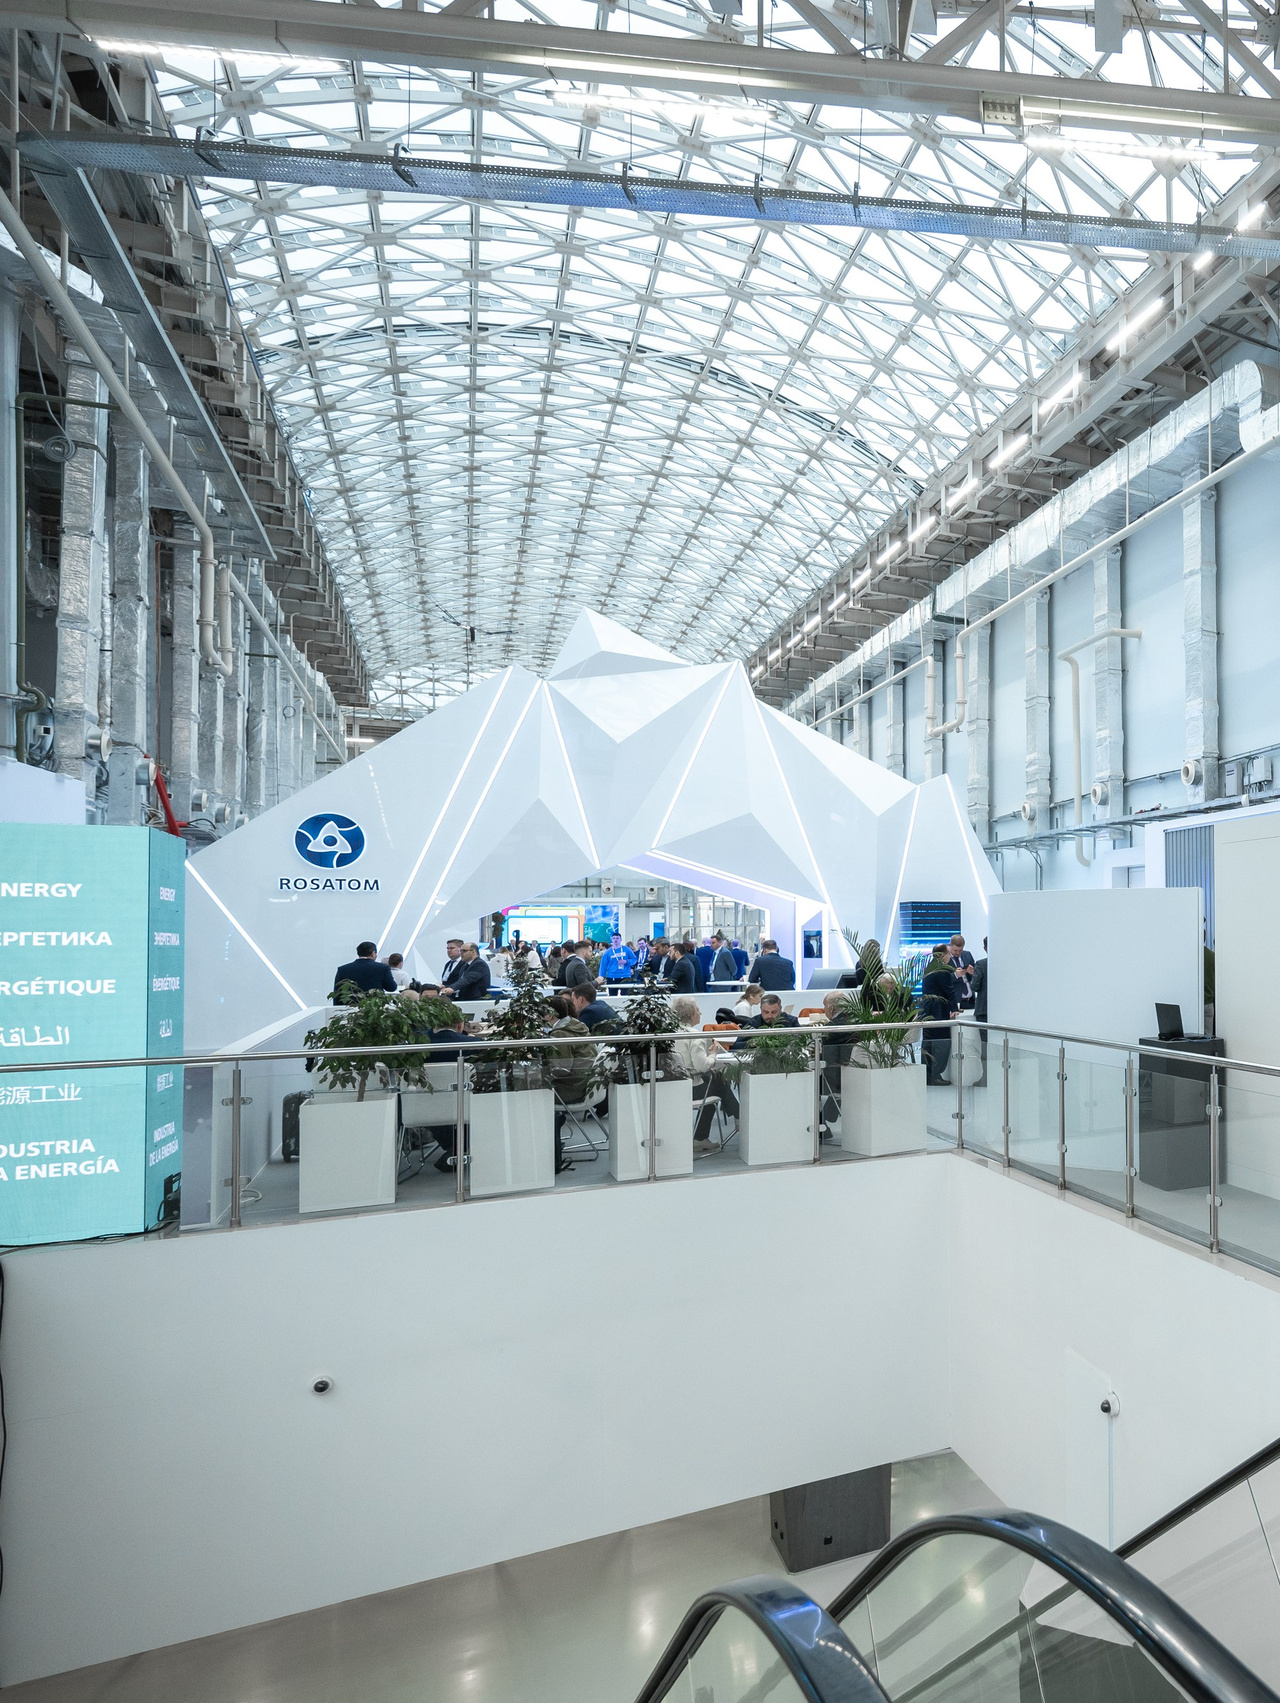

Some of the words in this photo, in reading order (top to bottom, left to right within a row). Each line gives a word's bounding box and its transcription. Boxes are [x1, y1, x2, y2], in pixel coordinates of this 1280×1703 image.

[0, 882, 83, 898] NERGY
[279, 877, 380, 891] ROSATOM
[0, 931, 113, 947] РГЕТИКА
[0, 976, 117, 997] RGÉTIQUE
[15, 1155, 120, 1180] ENERGÍA
